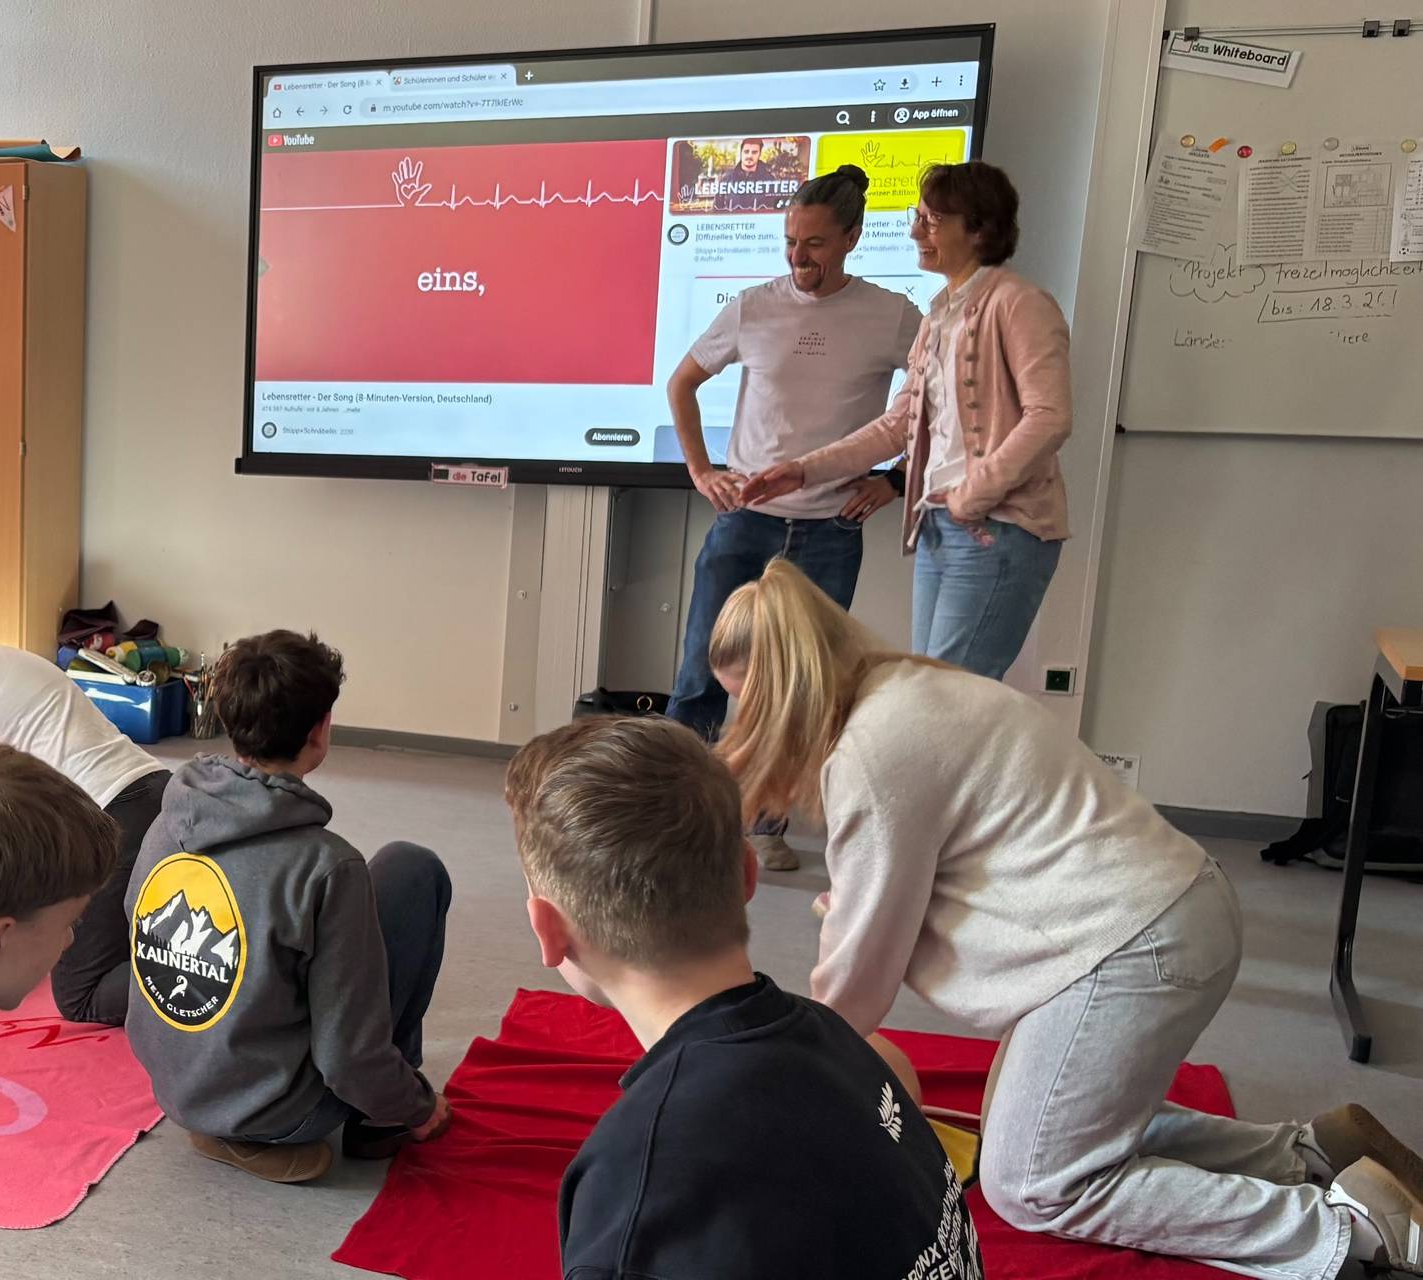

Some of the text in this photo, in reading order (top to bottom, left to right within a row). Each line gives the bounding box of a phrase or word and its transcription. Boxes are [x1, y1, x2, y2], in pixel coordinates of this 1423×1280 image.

[1191, 43, 1287, 66] das Whiteboard
[446, 75, 460, 83] und
[912, 107, 959, 121] App öffnen
[283, 133, 315, 146] YouTube
[693, 180, 799, 195] LEBENSRETTER
[696, 223, 756, 231] LEBENSRETTER
[735, 232, 756, 241] Video
[417, 267, 486, 296] eins,
[261, 392, 311, 402] Lebensretter
[317, 393, 332, 402] Der
[333, 393, 354, 404] Song
[436, 393, 493, 405] Deutschland)
[592, 431, 633, 444] Abonnieren
[452, 471, 501, 484] die Tafel
[136, 940, 229, 984] KAUNERTAL
[145, 975, 220, 1018] MEIN GLETSCHER
[901, 1241, 943, 1280] RONX
